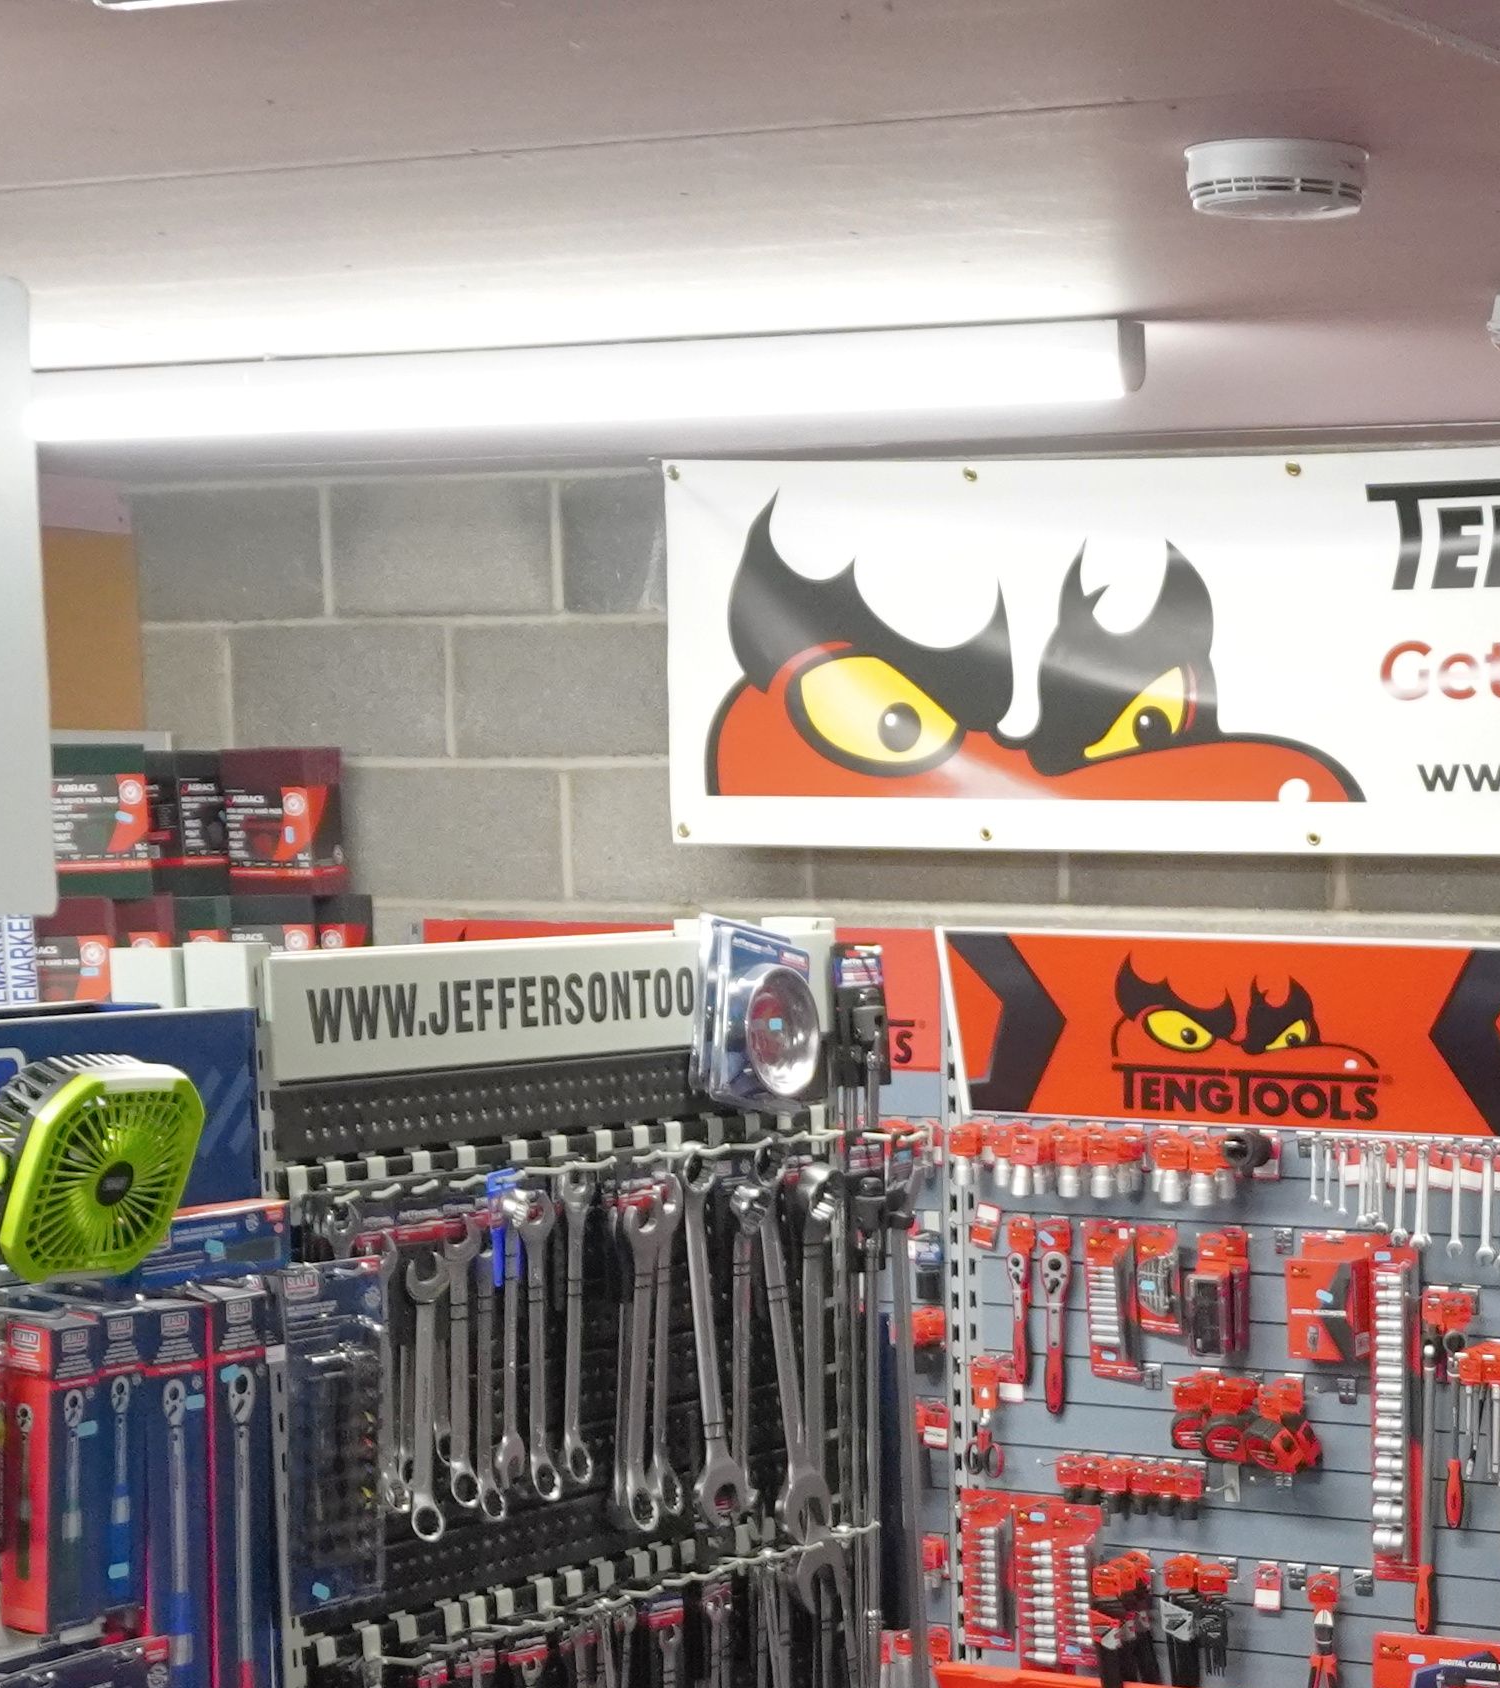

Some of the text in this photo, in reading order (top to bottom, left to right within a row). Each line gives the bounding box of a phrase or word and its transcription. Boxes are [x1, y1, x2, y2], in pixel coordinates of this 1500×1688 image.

[56, 784, 98, 793] ABRACS
[1117, 1064, 1378, 1123] TENGTOOLS
[1438, 1658, 1497, 1671] DIGITAL CALIPER
